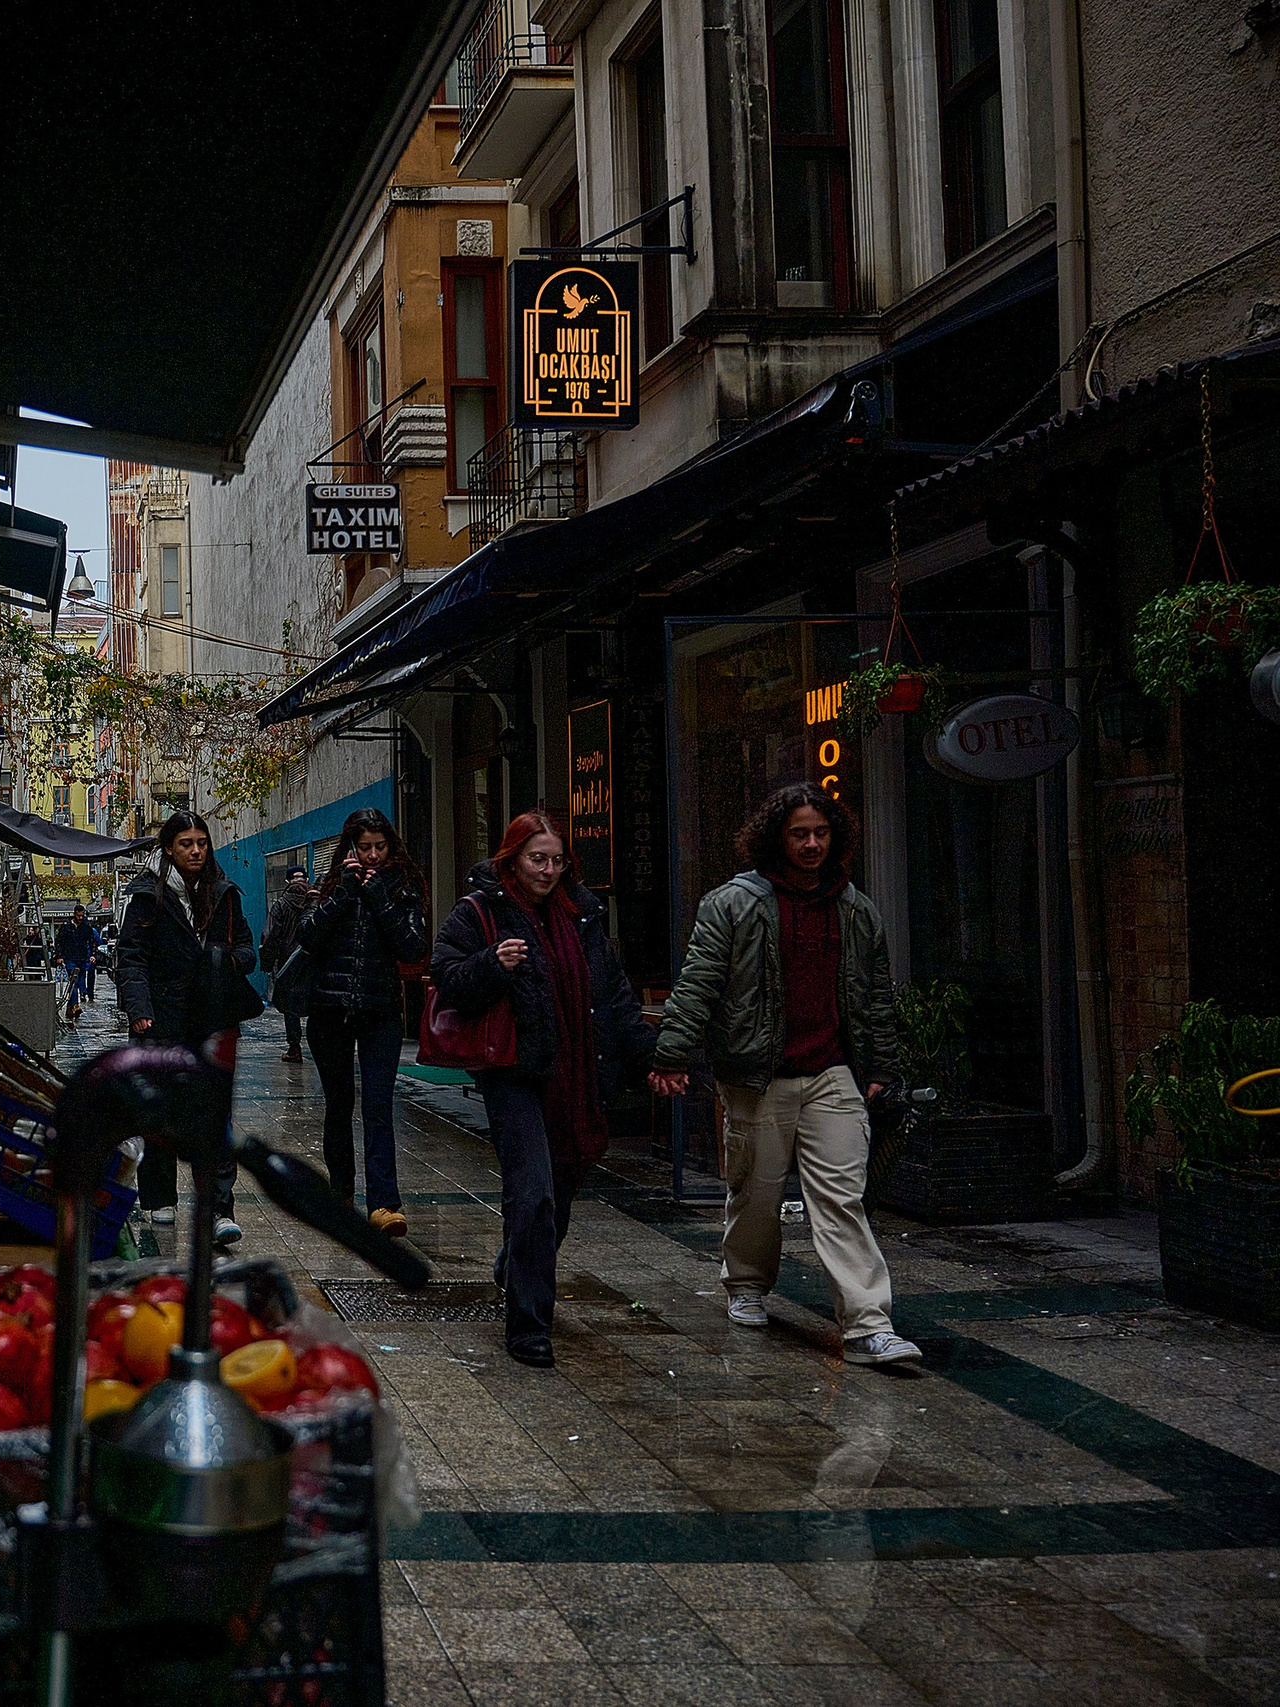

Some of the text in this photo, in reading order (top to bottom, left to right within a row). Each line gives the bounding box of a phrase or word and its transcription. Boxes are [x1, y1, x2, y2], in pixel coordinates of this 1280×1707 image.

[557, 327, 600, 354] UMUT
[539, 353, 616, 384] OCAKBAŞI
[565, 381, 590, 400] 1976
[320, 487, 391, 497] GH SUITES
[311, 507, 399, 527] TAXIM
[311, 530, 399, 549] HOTEL
[958, 713, 1069, 754] OTEL
